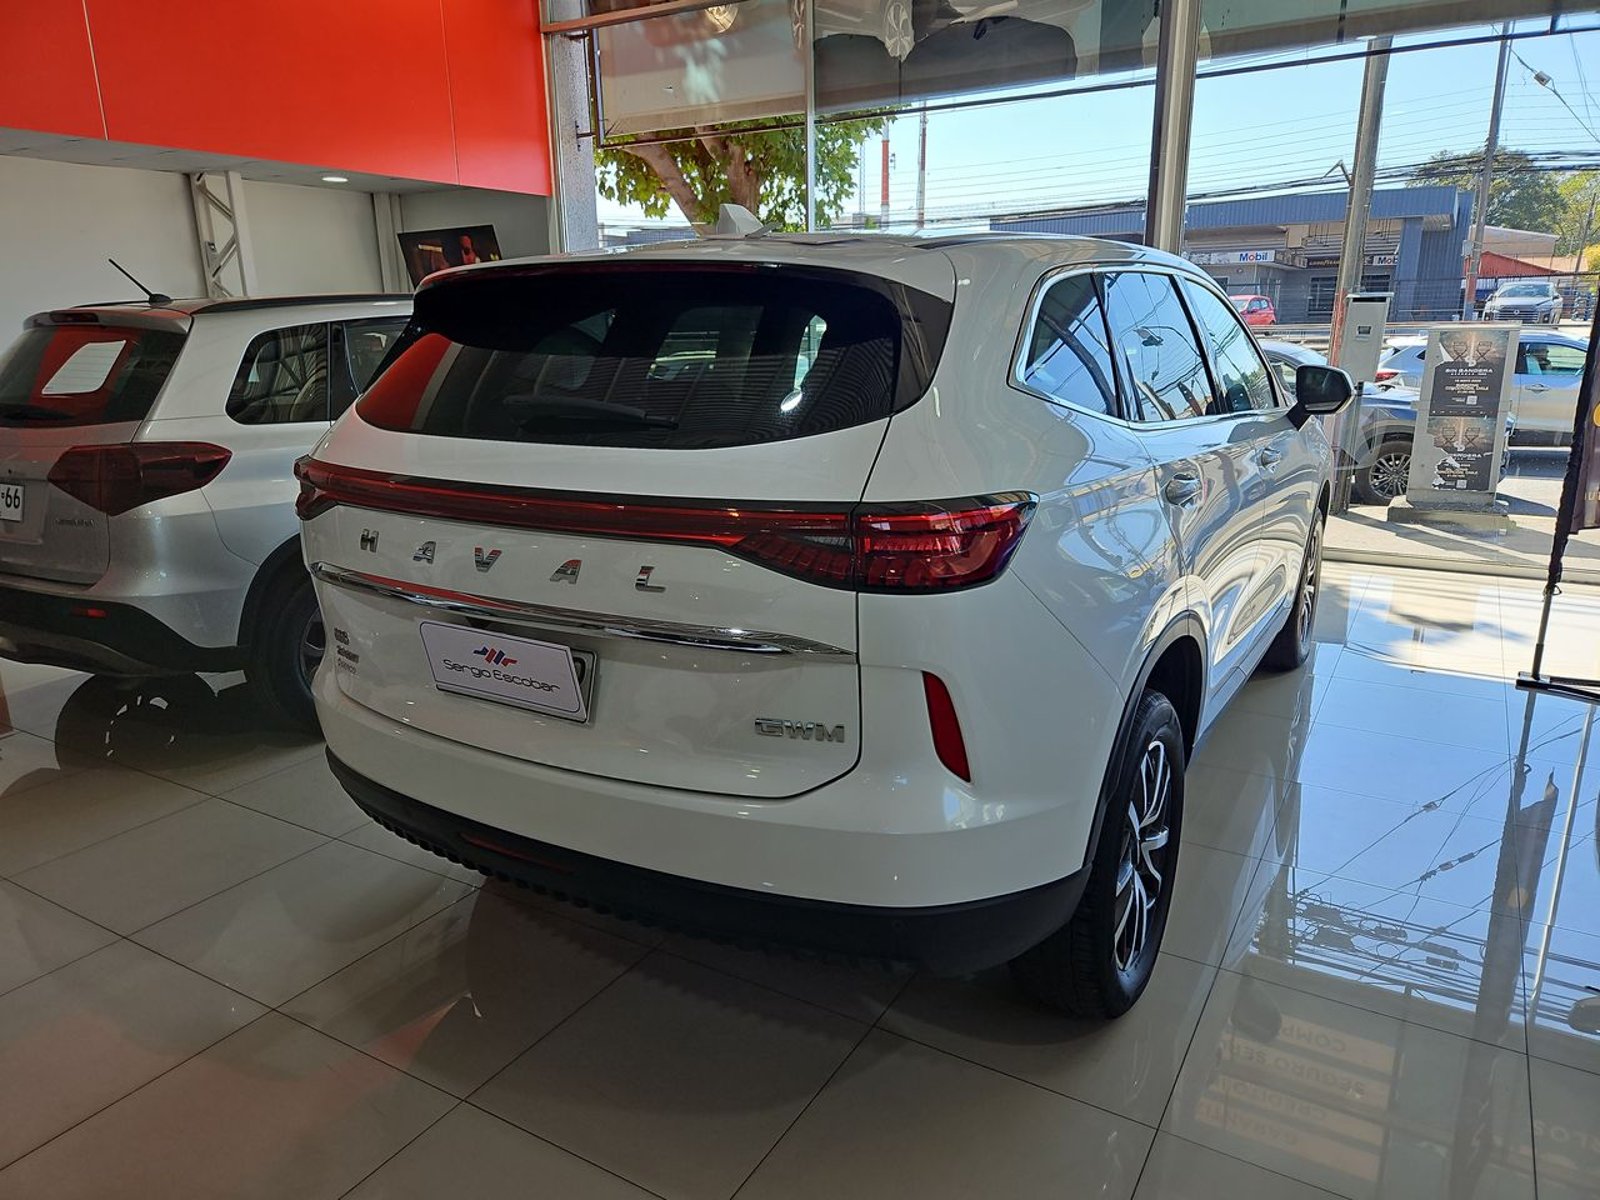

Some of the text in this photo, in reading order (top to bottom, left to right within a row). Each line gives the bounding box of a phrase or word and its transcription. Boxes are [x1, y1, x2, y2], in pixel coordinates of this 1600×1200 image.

[1239, 251, 1268, 262] Mobil
[360, 528, 666, 593] HAVAL
[493, 669, 561, 692] Escobar
[755, 718, 845, 743] GWM
